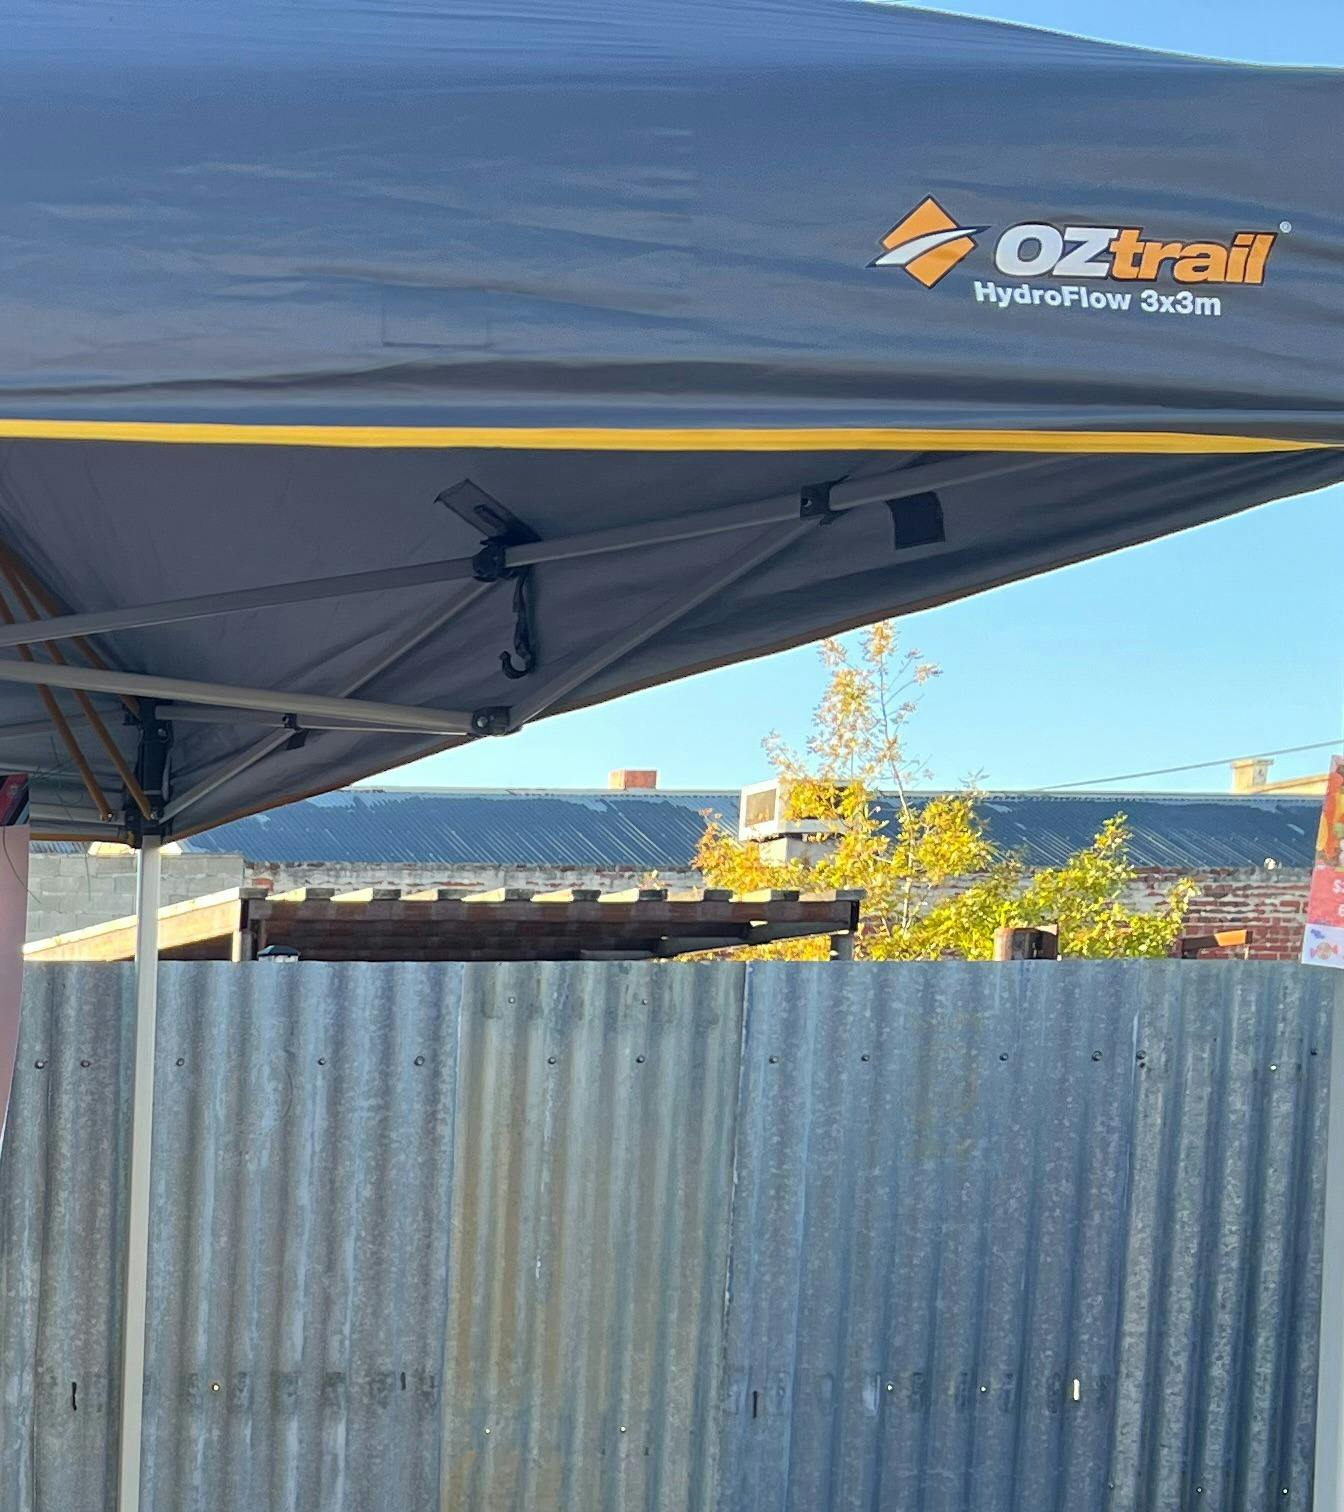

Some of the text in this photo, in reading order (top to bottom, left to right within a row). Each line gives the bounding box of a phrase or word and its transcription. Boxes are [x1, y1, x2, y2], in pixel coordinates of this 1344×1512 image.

[994, 221, 1278, 285] OZtrail
[973, 280, 1222, 317] HydroFlow 3x3m
